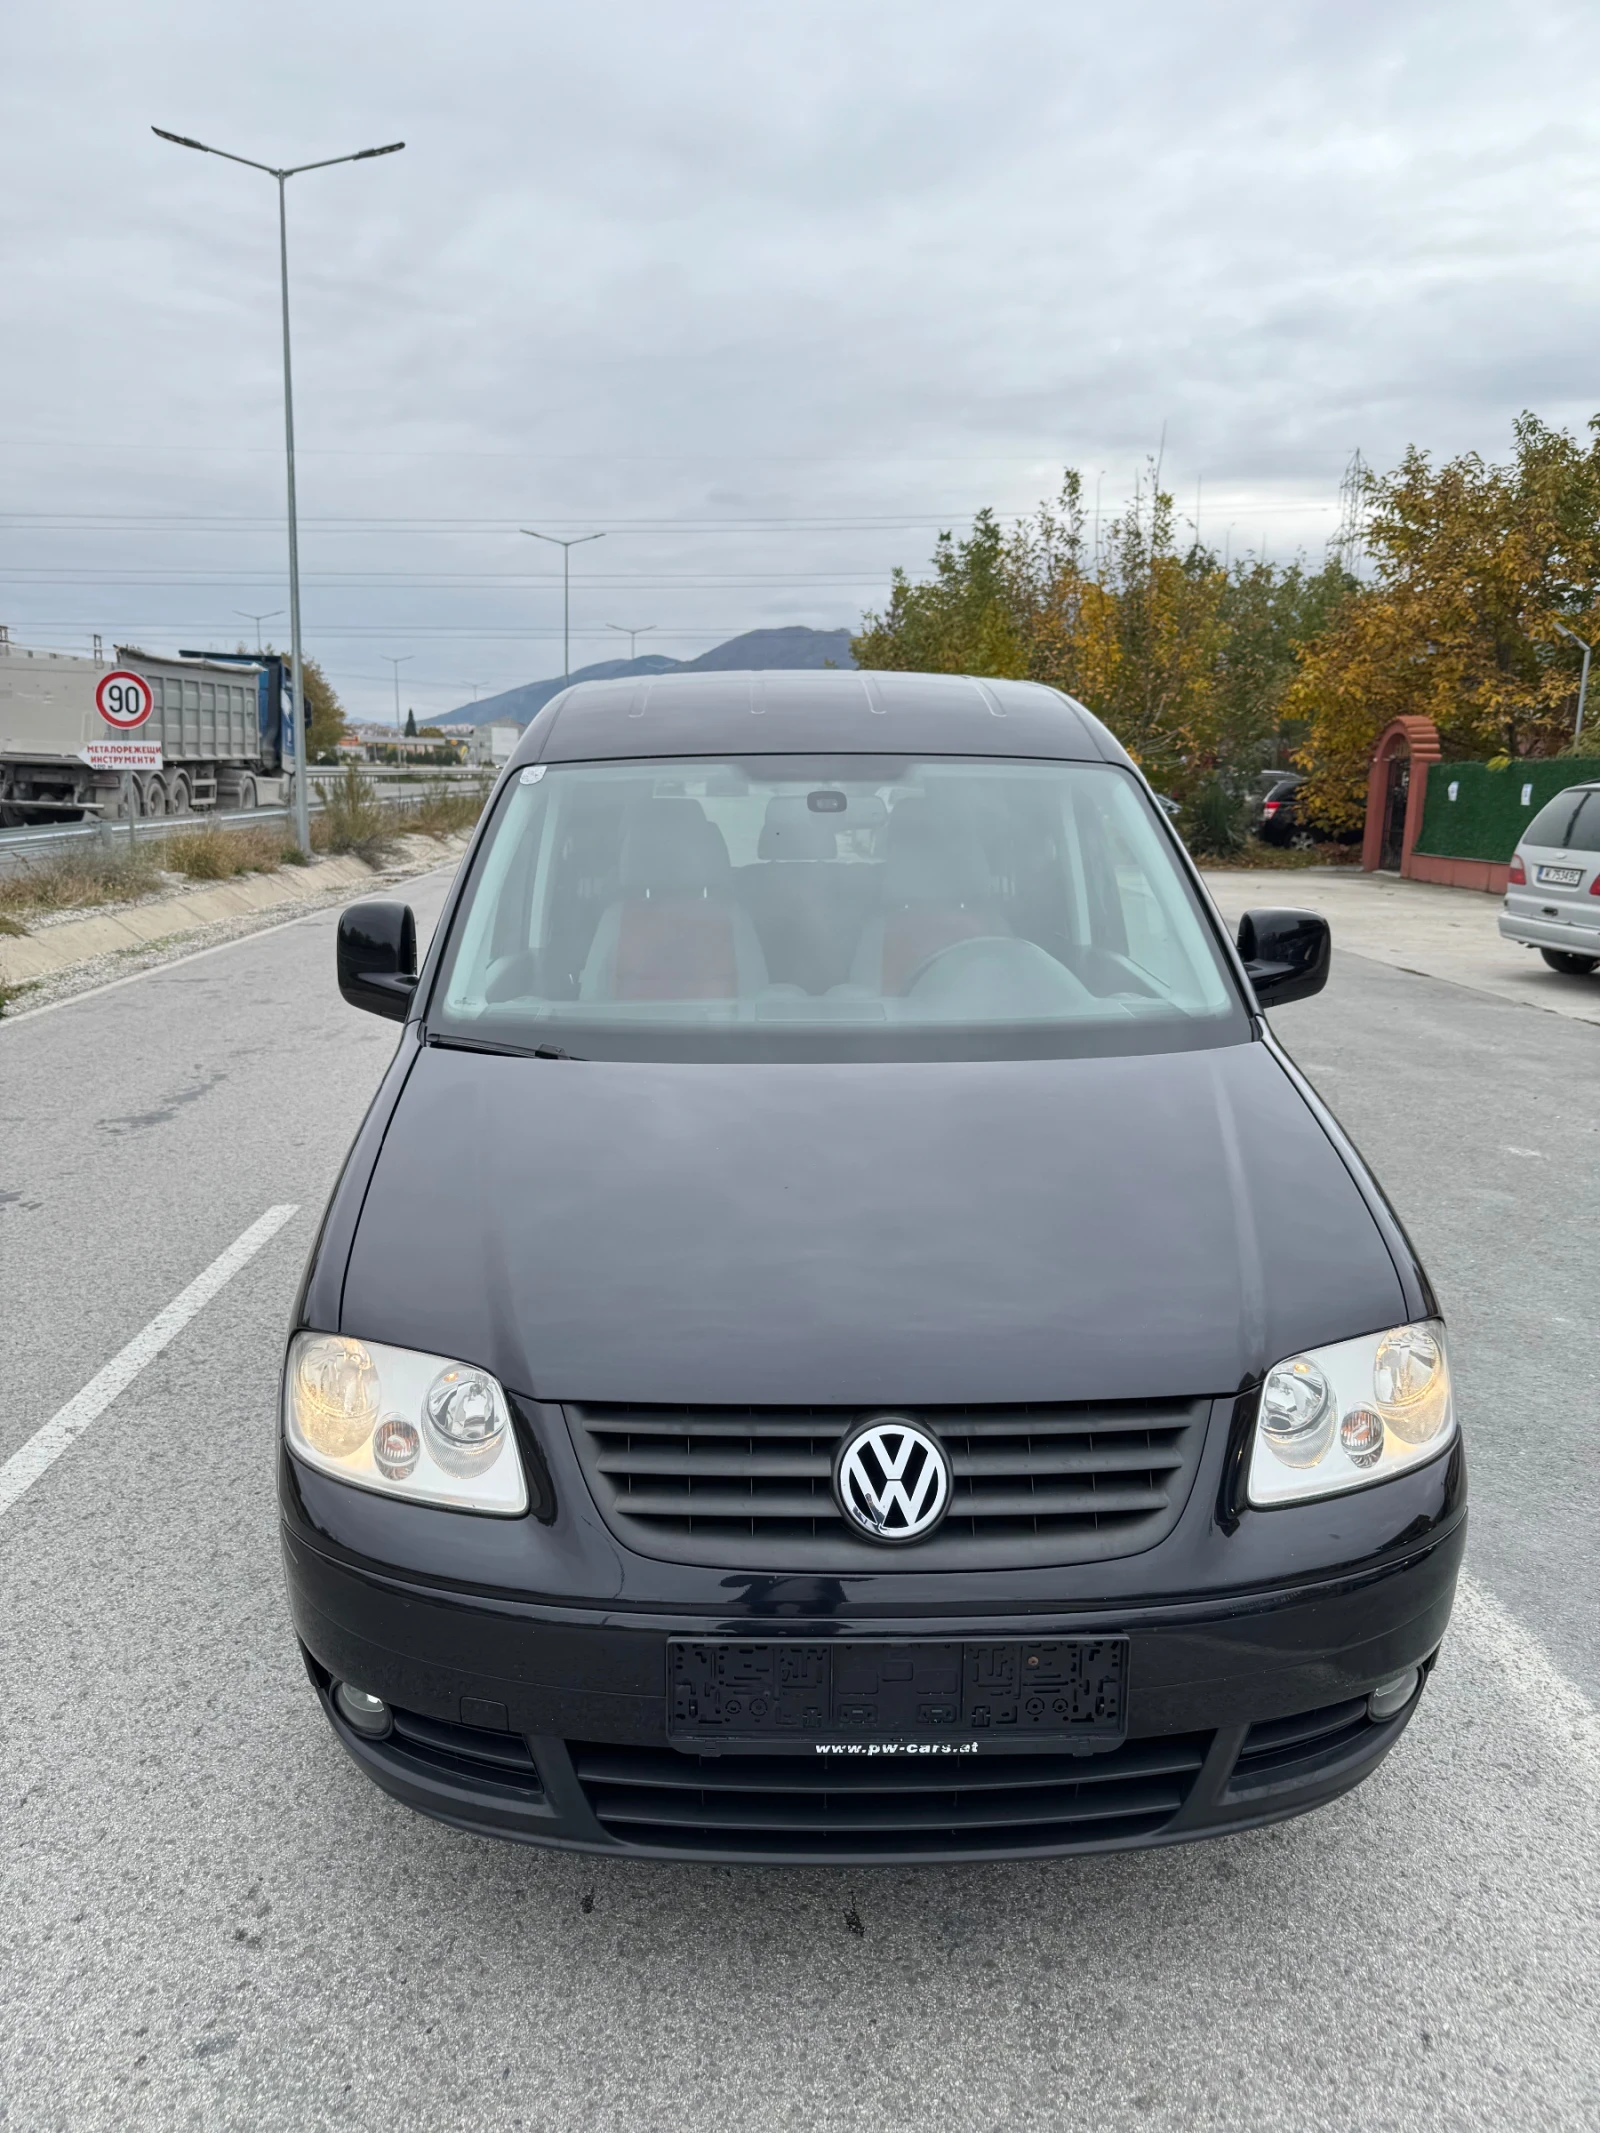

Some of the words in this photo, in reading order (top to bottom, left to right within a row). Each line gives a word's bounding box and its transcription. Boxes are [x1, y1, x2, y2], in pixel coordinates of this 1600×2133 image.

[109, 685, 139, 714] 90
[87, 745, 162, 754] МЕТАЛОРЕЖЕЩИ
[91, 756, 156, 764] ИНСТРУМЕНТИ
[815, 1742, 979, 1756] www.pw-cars.at
